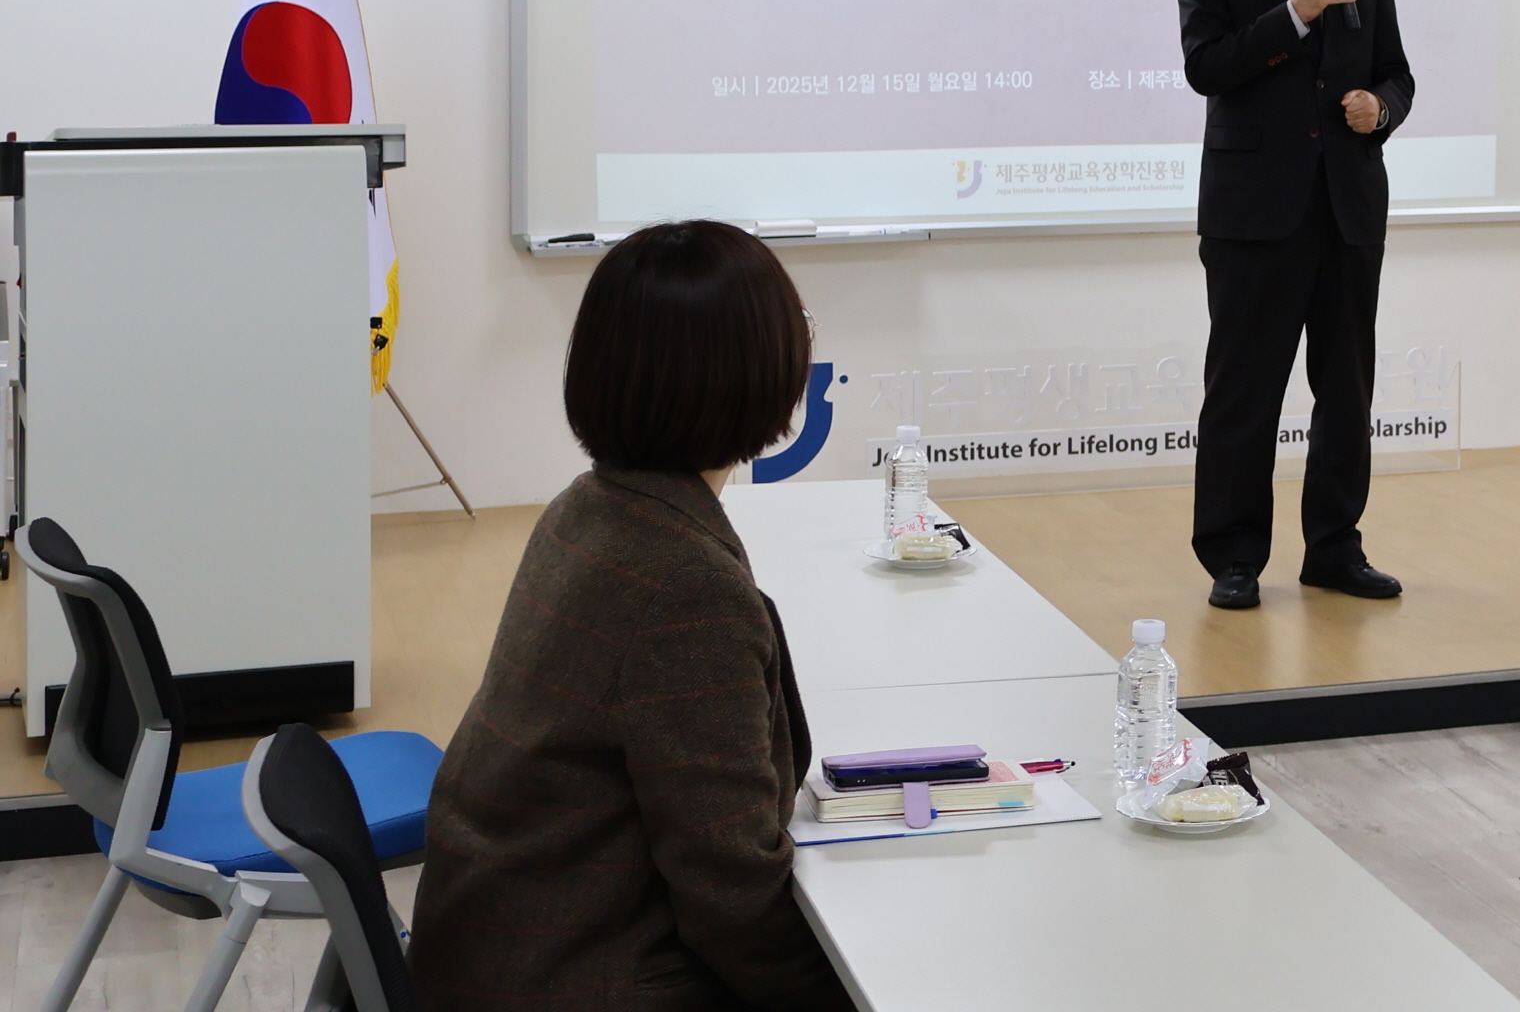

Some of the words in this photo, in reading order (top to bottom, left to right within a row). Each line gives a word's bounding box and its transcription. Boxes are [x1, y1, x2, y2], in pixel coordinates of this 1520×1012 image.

[712, 76, 746, 96] 일시
[767, 75, 829, 95] 2025년
[837, 74, 875, 94] 12월
[883, 72, 921, 93] 15일
[928, 71, 977, 92] 월요일
[985, 70, 1033, 89] 14:00
[1088, 70, 1121, 90] 장소
[1139, 69, 1186, 90] 제주평
[995, 160, 1185, 184] 제주평생교육장학진흥원
[926, 441, 1023, 463] Institute
[1029, 438, 1061, 458] for
[1067, 434, 1158, 456] Lifelong
